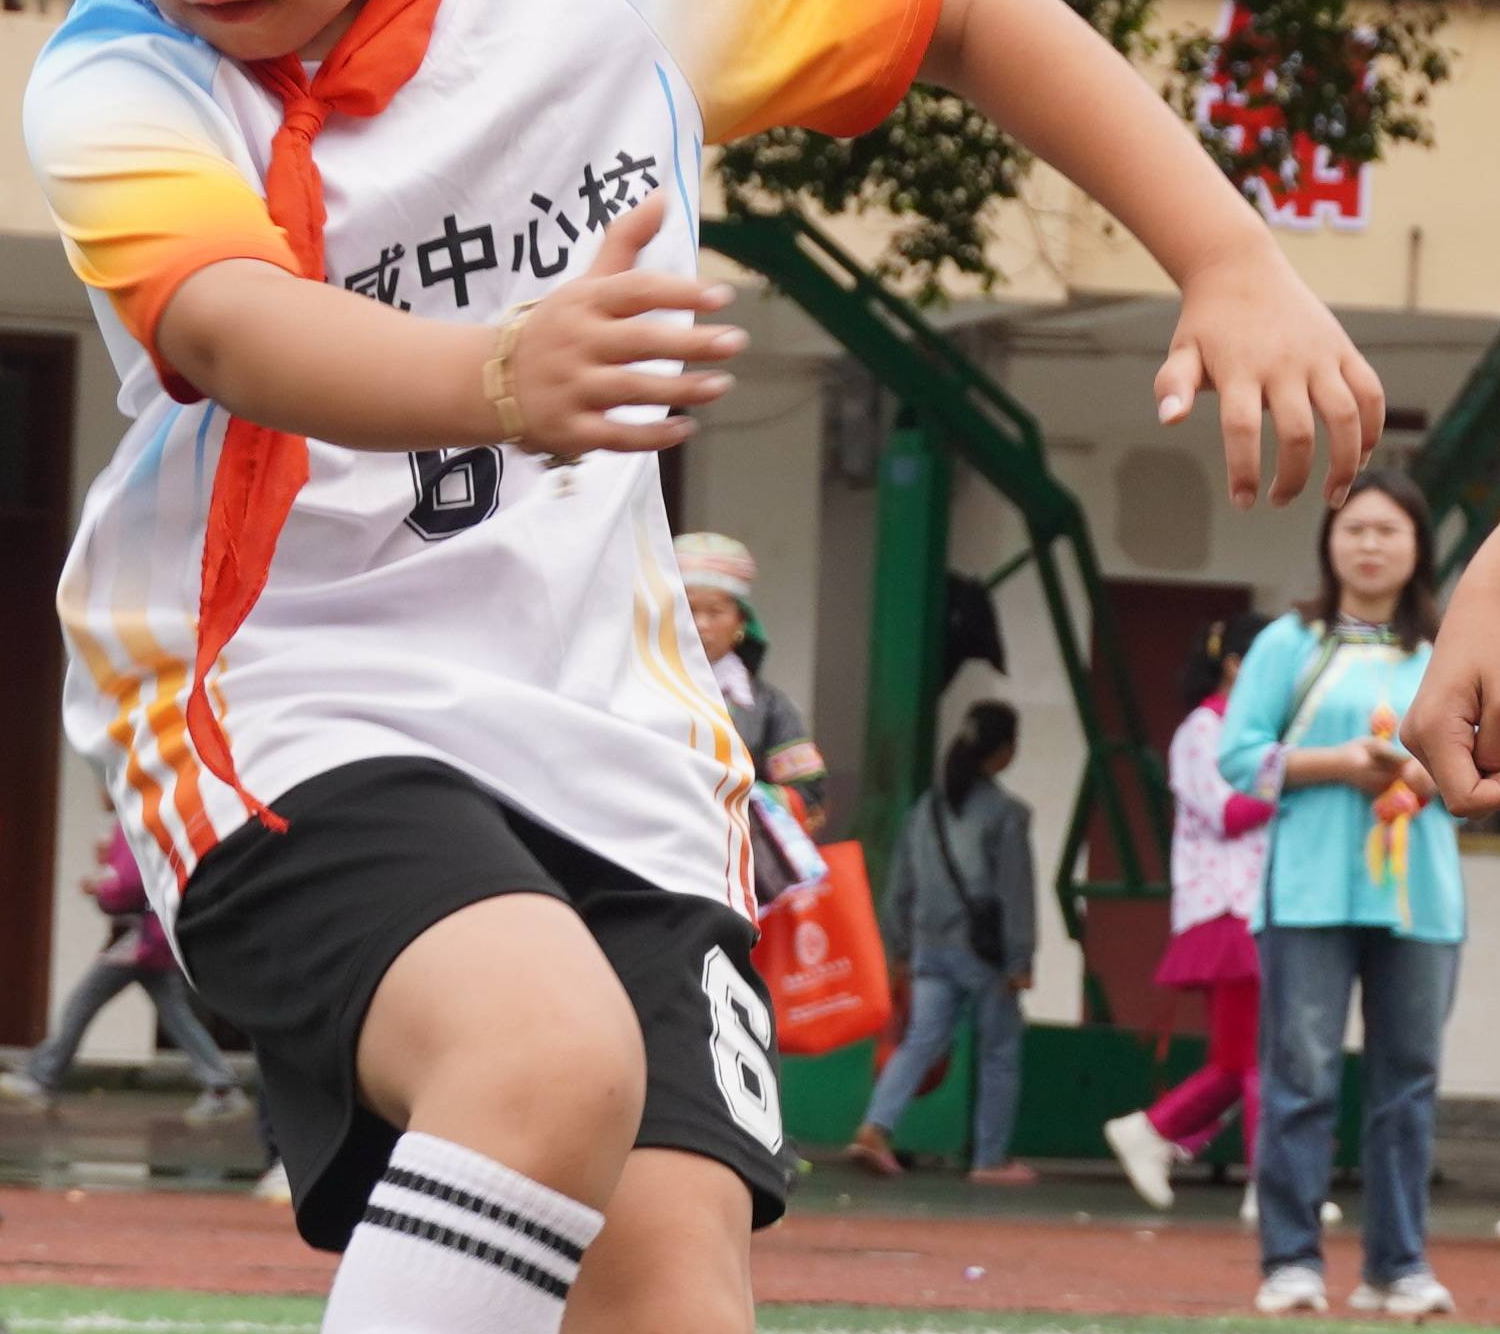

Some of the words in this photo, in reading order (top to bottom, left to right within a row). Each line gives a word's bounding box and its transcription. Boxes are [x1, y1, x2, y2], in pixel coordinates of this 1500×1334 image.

[325, 150, 662, 313] 威中心校
[701, 944, 783, 1156] 6
